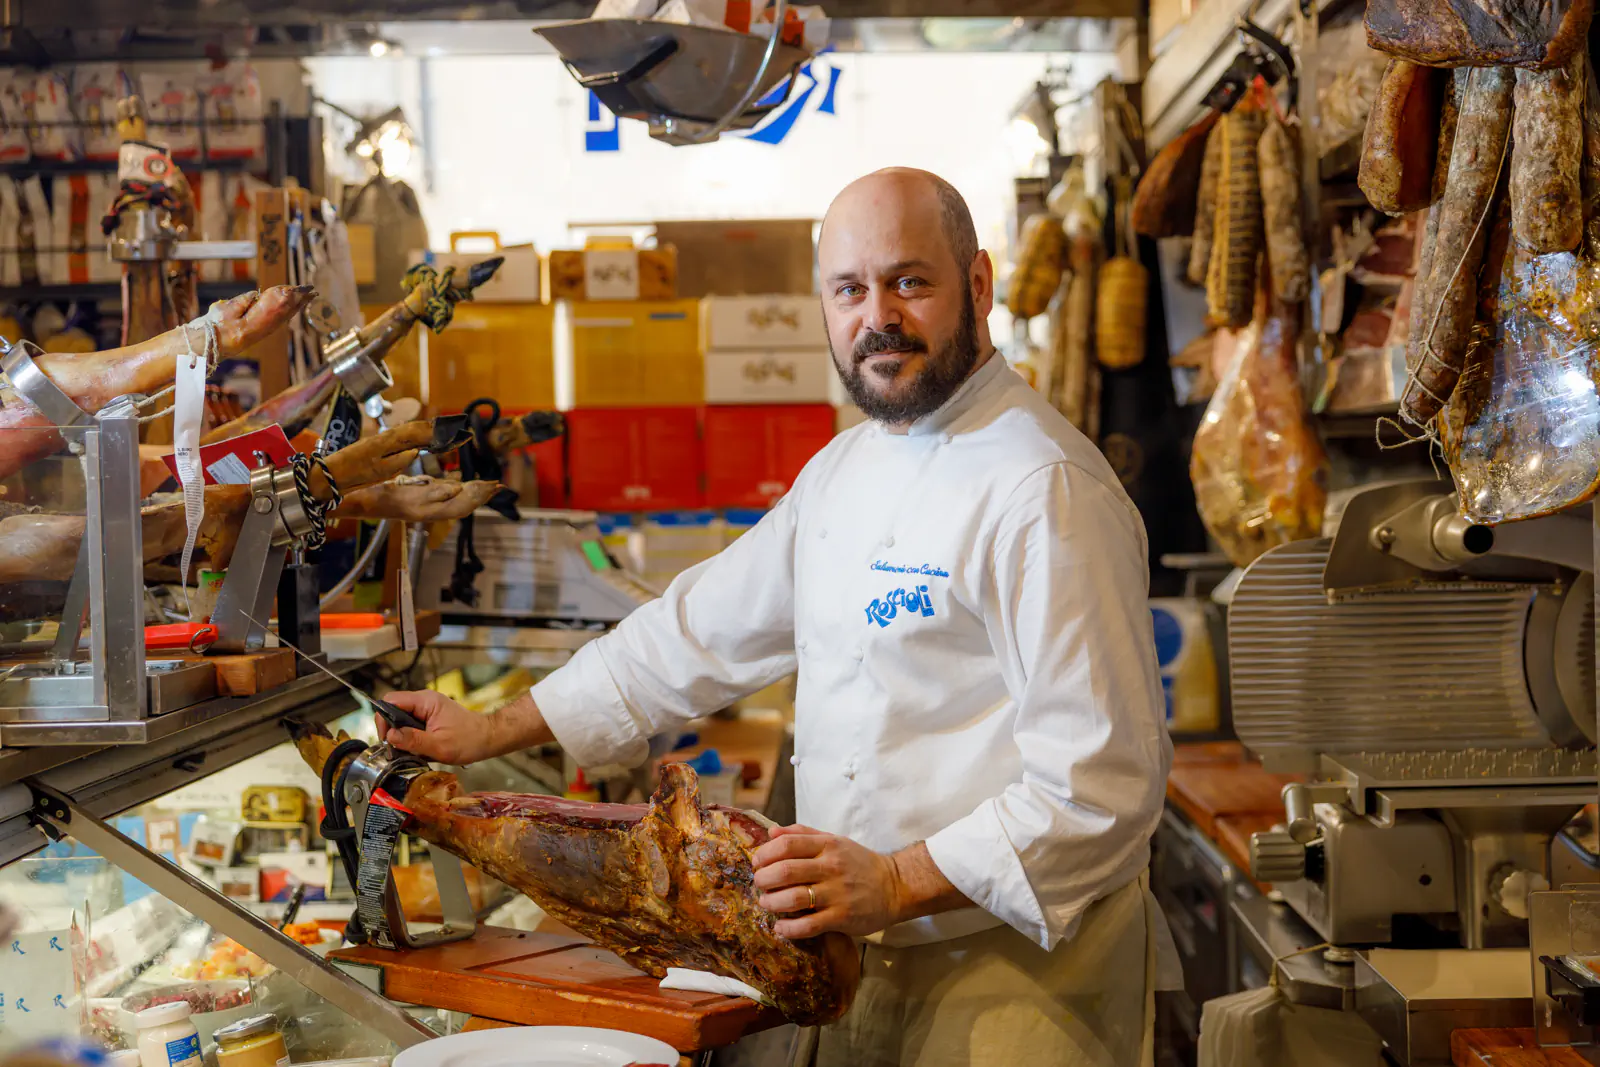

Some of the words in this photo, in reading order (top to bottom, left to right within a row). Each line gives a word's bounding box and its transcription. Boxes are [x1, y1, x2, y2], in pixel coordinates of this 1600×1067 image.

[920, 563, 949, 577] Cucina
[11, 940, 26, 955] R
[49, 936, 64, 952] R
[16, 997, 31, 1013] R
[53, 994, 68, 1009] R
